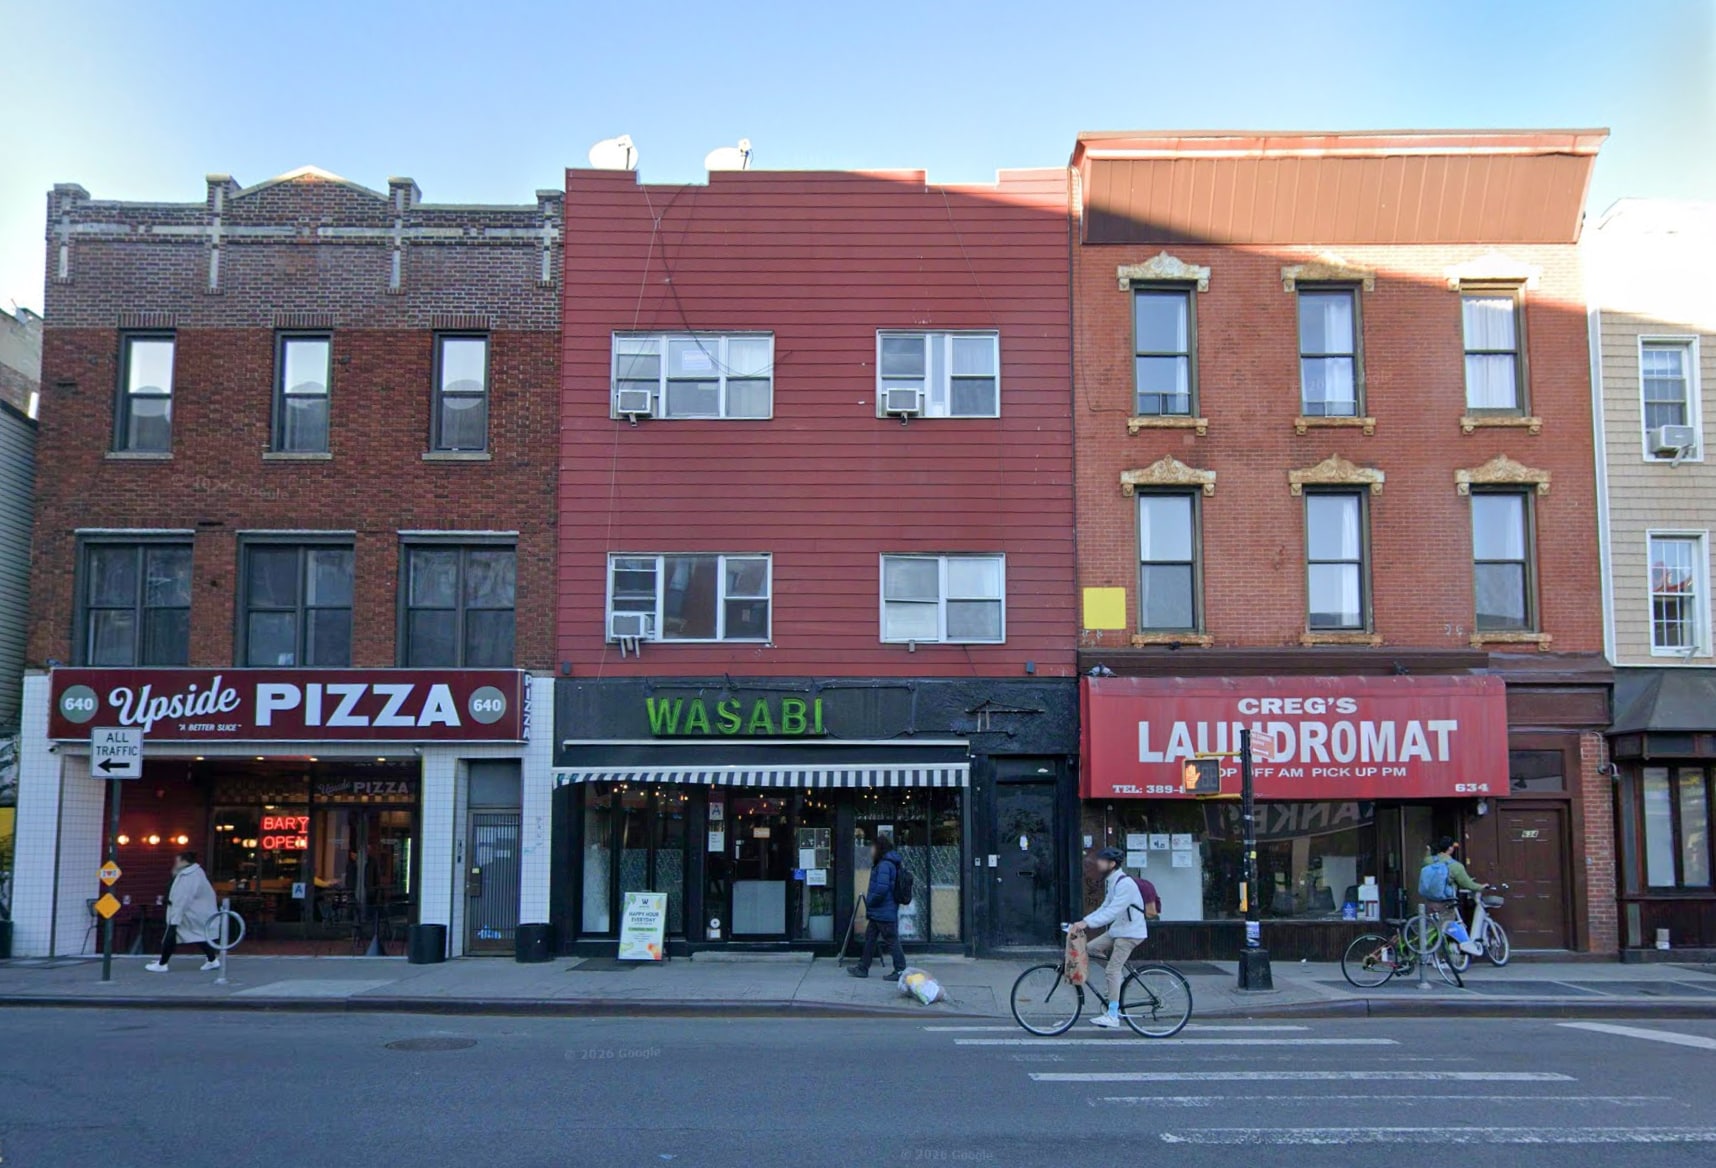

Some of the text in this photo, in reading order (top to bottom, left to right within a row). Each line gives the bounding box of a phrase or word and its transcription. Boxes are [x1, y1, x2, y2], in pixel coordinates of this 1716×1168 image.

[64, 697, 94, 711] 640
[109, 675, 462, 733] Upside PIZZA
[473, 699, 502, 712] 640
[523, 674, 533, 739] PIZZA
[1238, 697, 1358, 715] CREG'S
[646, 697, 824, 736] WASABI
[106, 732, 129, 743] ALL
[96, 746, 138, 757] TRAFFIC
[1251, 767, 1275, 778] FF
[1278, 767, 1304, 778] AM
[1312, 767, 1351, 777] PICK
[1355, 767, 1378, 777] UP
[1382, 766, 1407, 777] PM
[352, 781, 409, 794] PIZZA
[1112, 784, 1143, 794] TEL:
[1455, 783, 1489, 793] 634
[263, 816, 296, 830] BAR
[262, 835, 308, 849] OPEN
